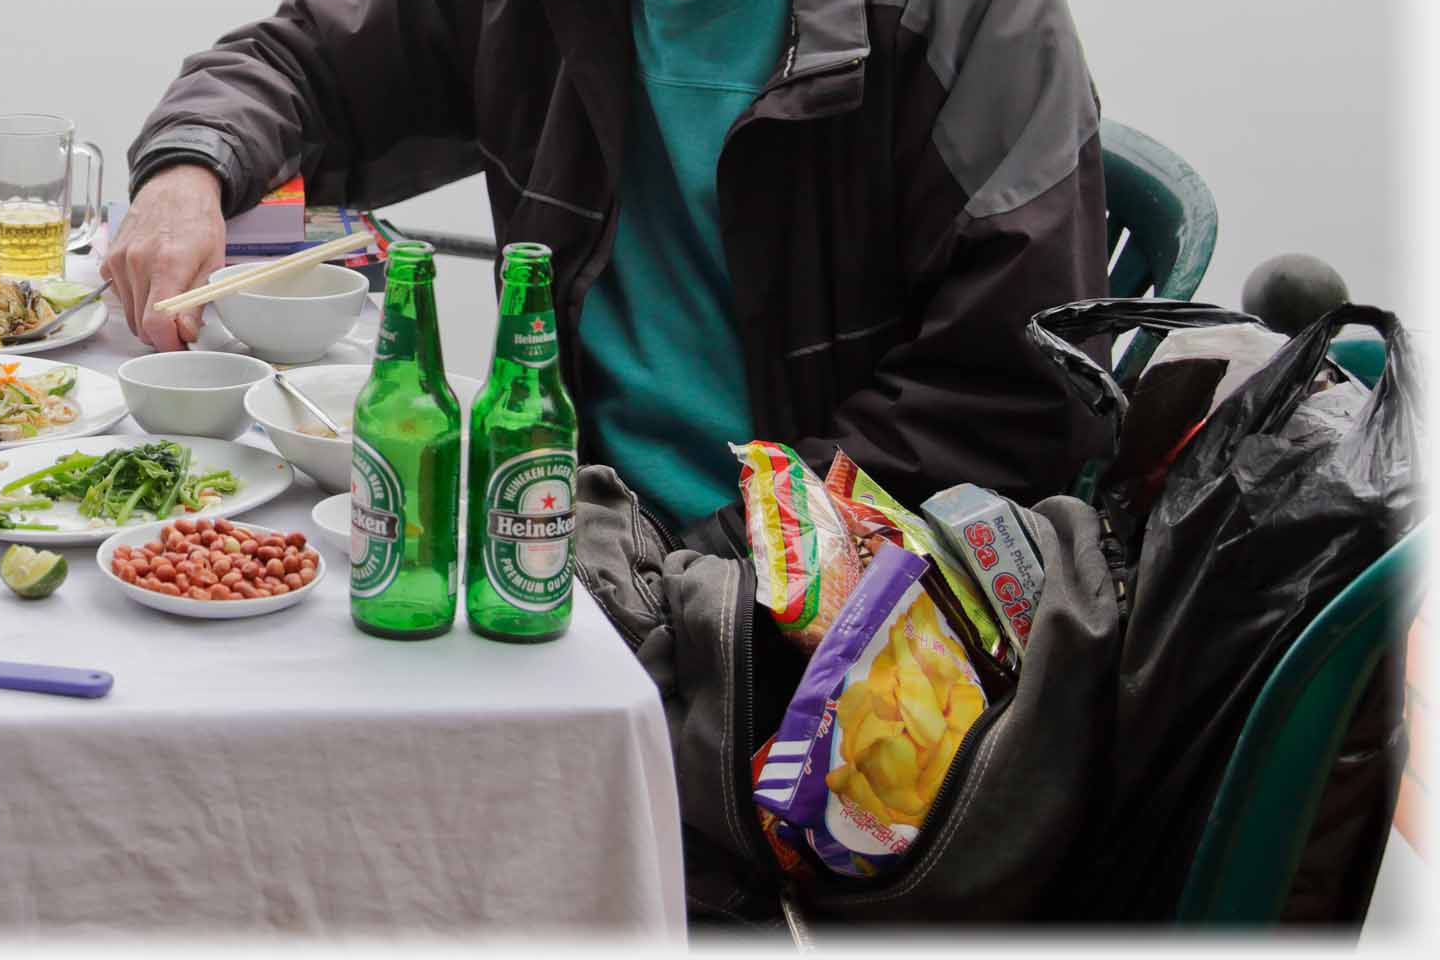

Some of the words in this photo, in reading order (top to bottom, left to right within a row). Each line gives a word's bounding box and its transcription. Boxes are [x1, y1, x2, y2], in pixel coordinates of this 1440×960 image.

[503, 465, 545, 502] HEINEKEN
[500, 557, 545, 593] PREMIUM
[963, 520, 1000, 572] Sa
[991, 571, 1033, 651] Gia
